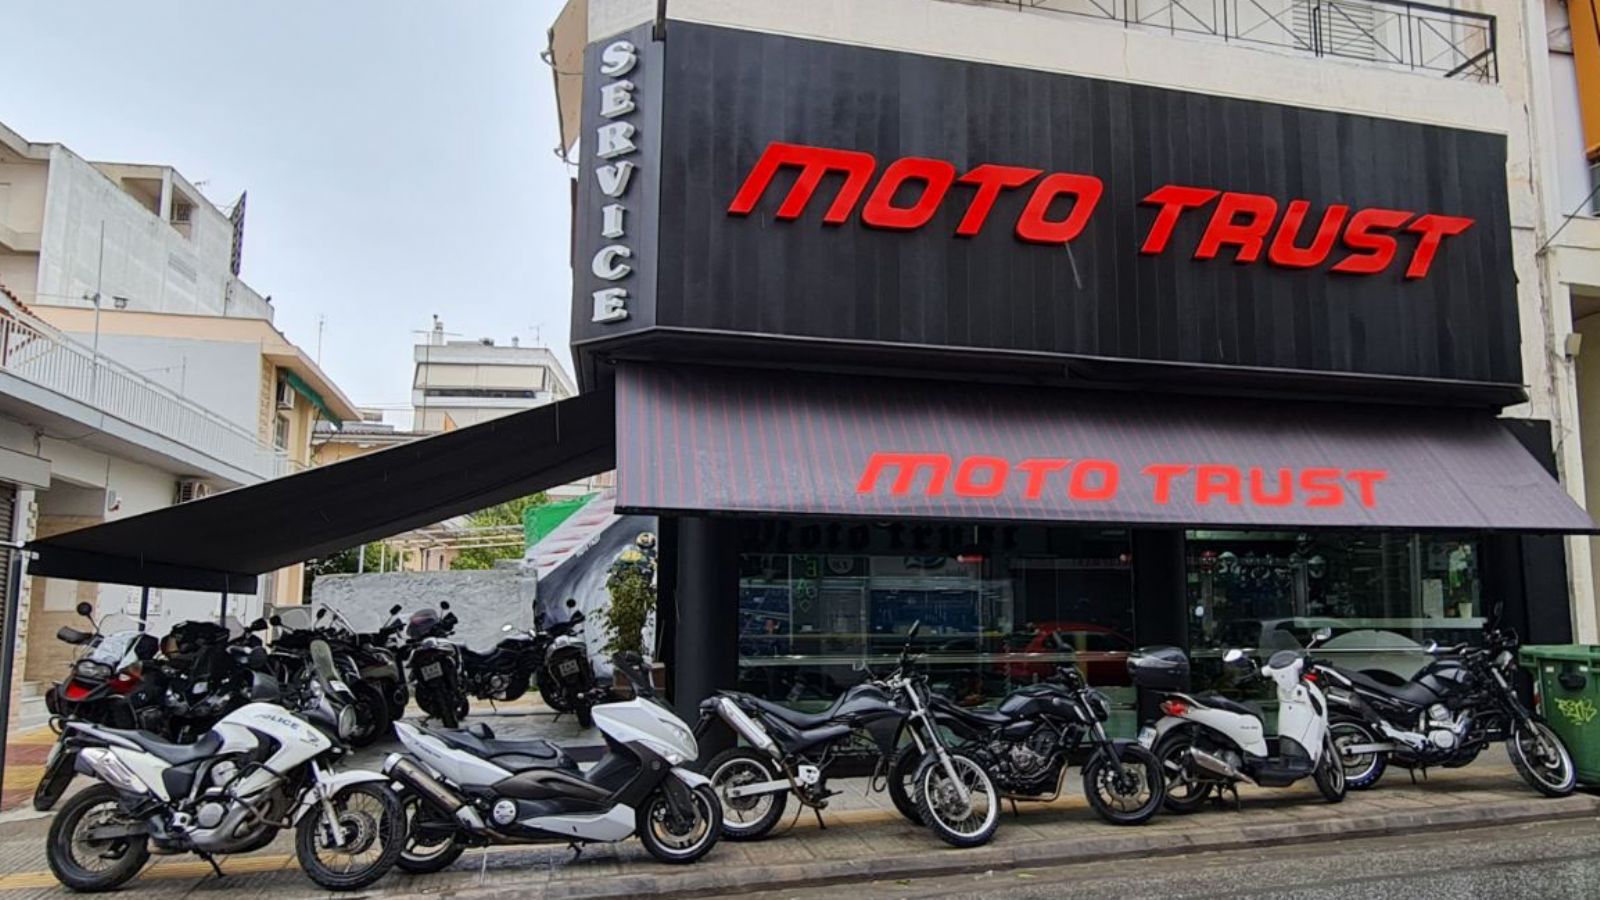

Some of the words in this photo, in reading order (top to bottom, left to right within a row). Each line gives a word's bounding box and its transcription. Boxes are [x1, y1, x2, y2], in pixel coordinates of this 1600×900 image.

[592, 40, 637, 323] SERVICE
[727, 140, 1105, 244] MOTO
[1140, 184, 1475, 280] TRUST
[856, 452, 1119, 501] MOTO
[1142, 463, 1387, 508] TRUST
